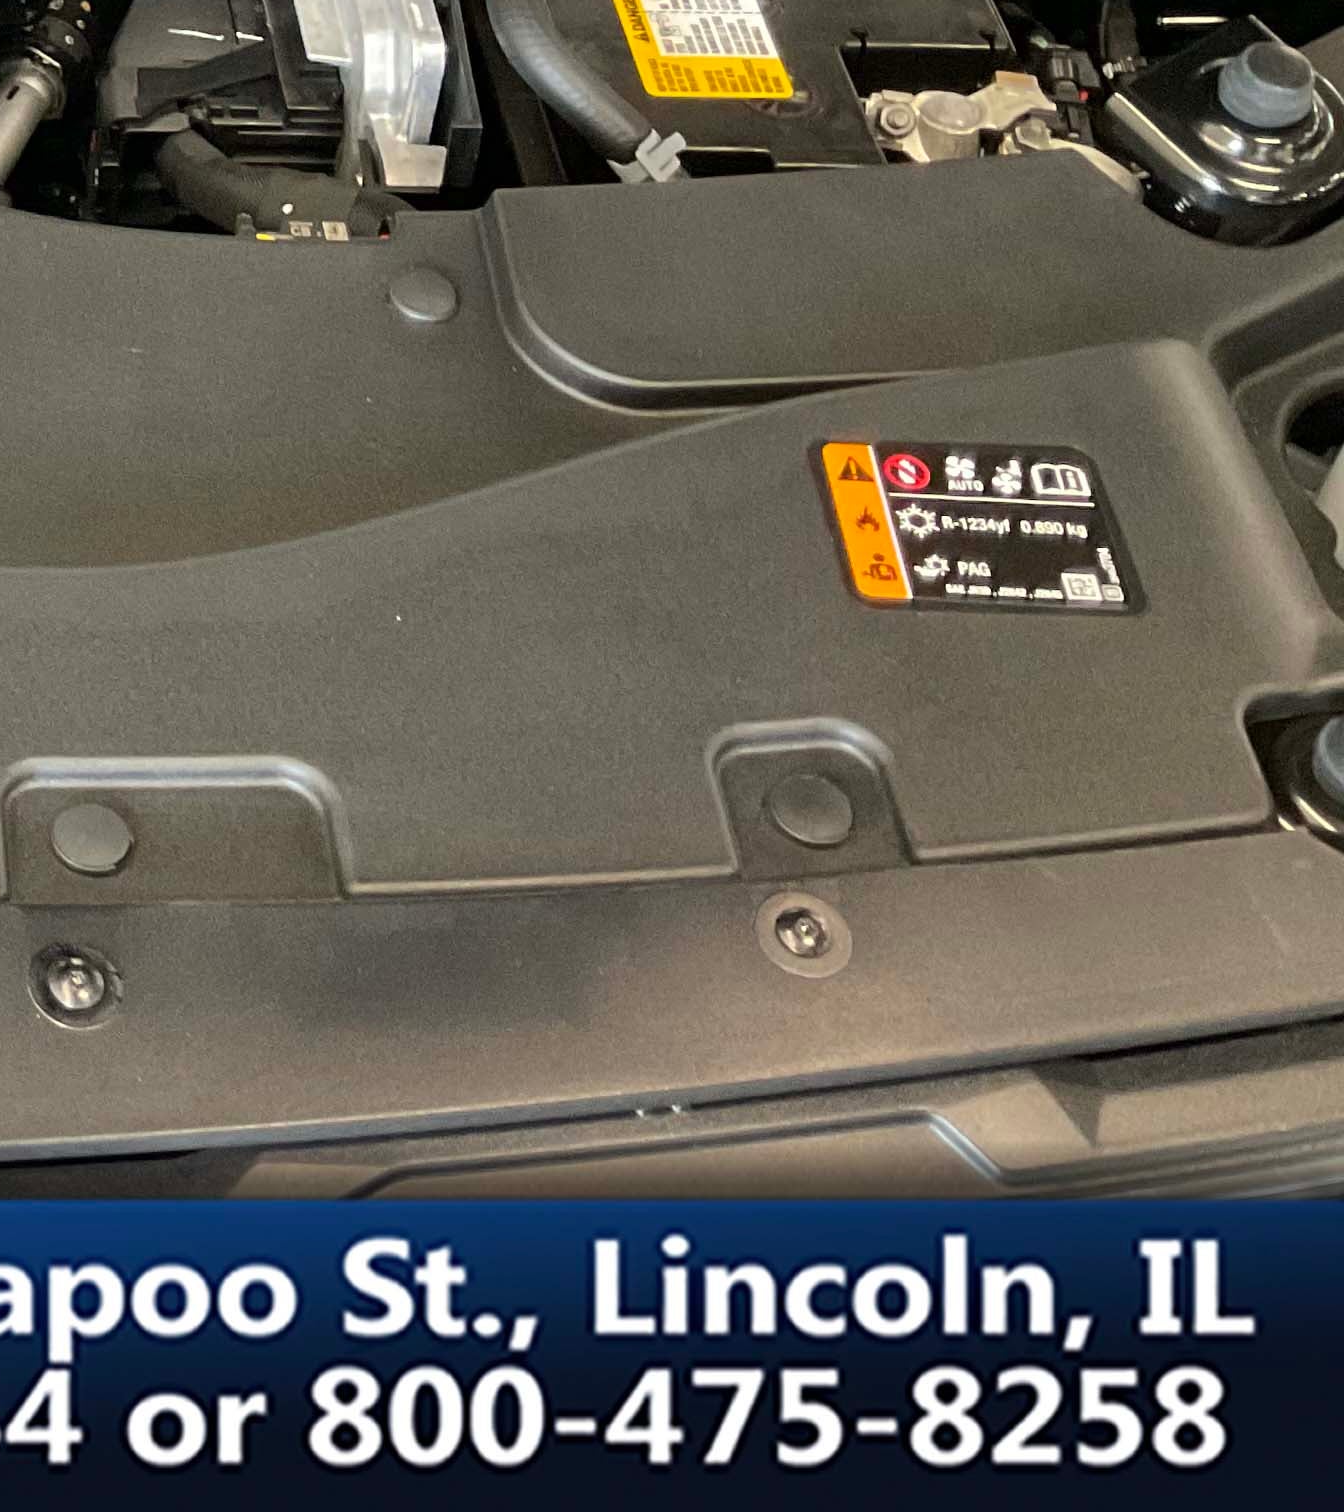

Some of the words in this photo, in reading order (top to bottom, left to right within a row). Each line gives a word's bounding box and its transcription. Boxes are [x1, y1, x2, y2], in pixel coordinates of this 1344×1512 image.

[947, 480, 985, 492] AUTO
[1065, 521, 1089, 539] kg
[956, 560, 993, 578] PAG
